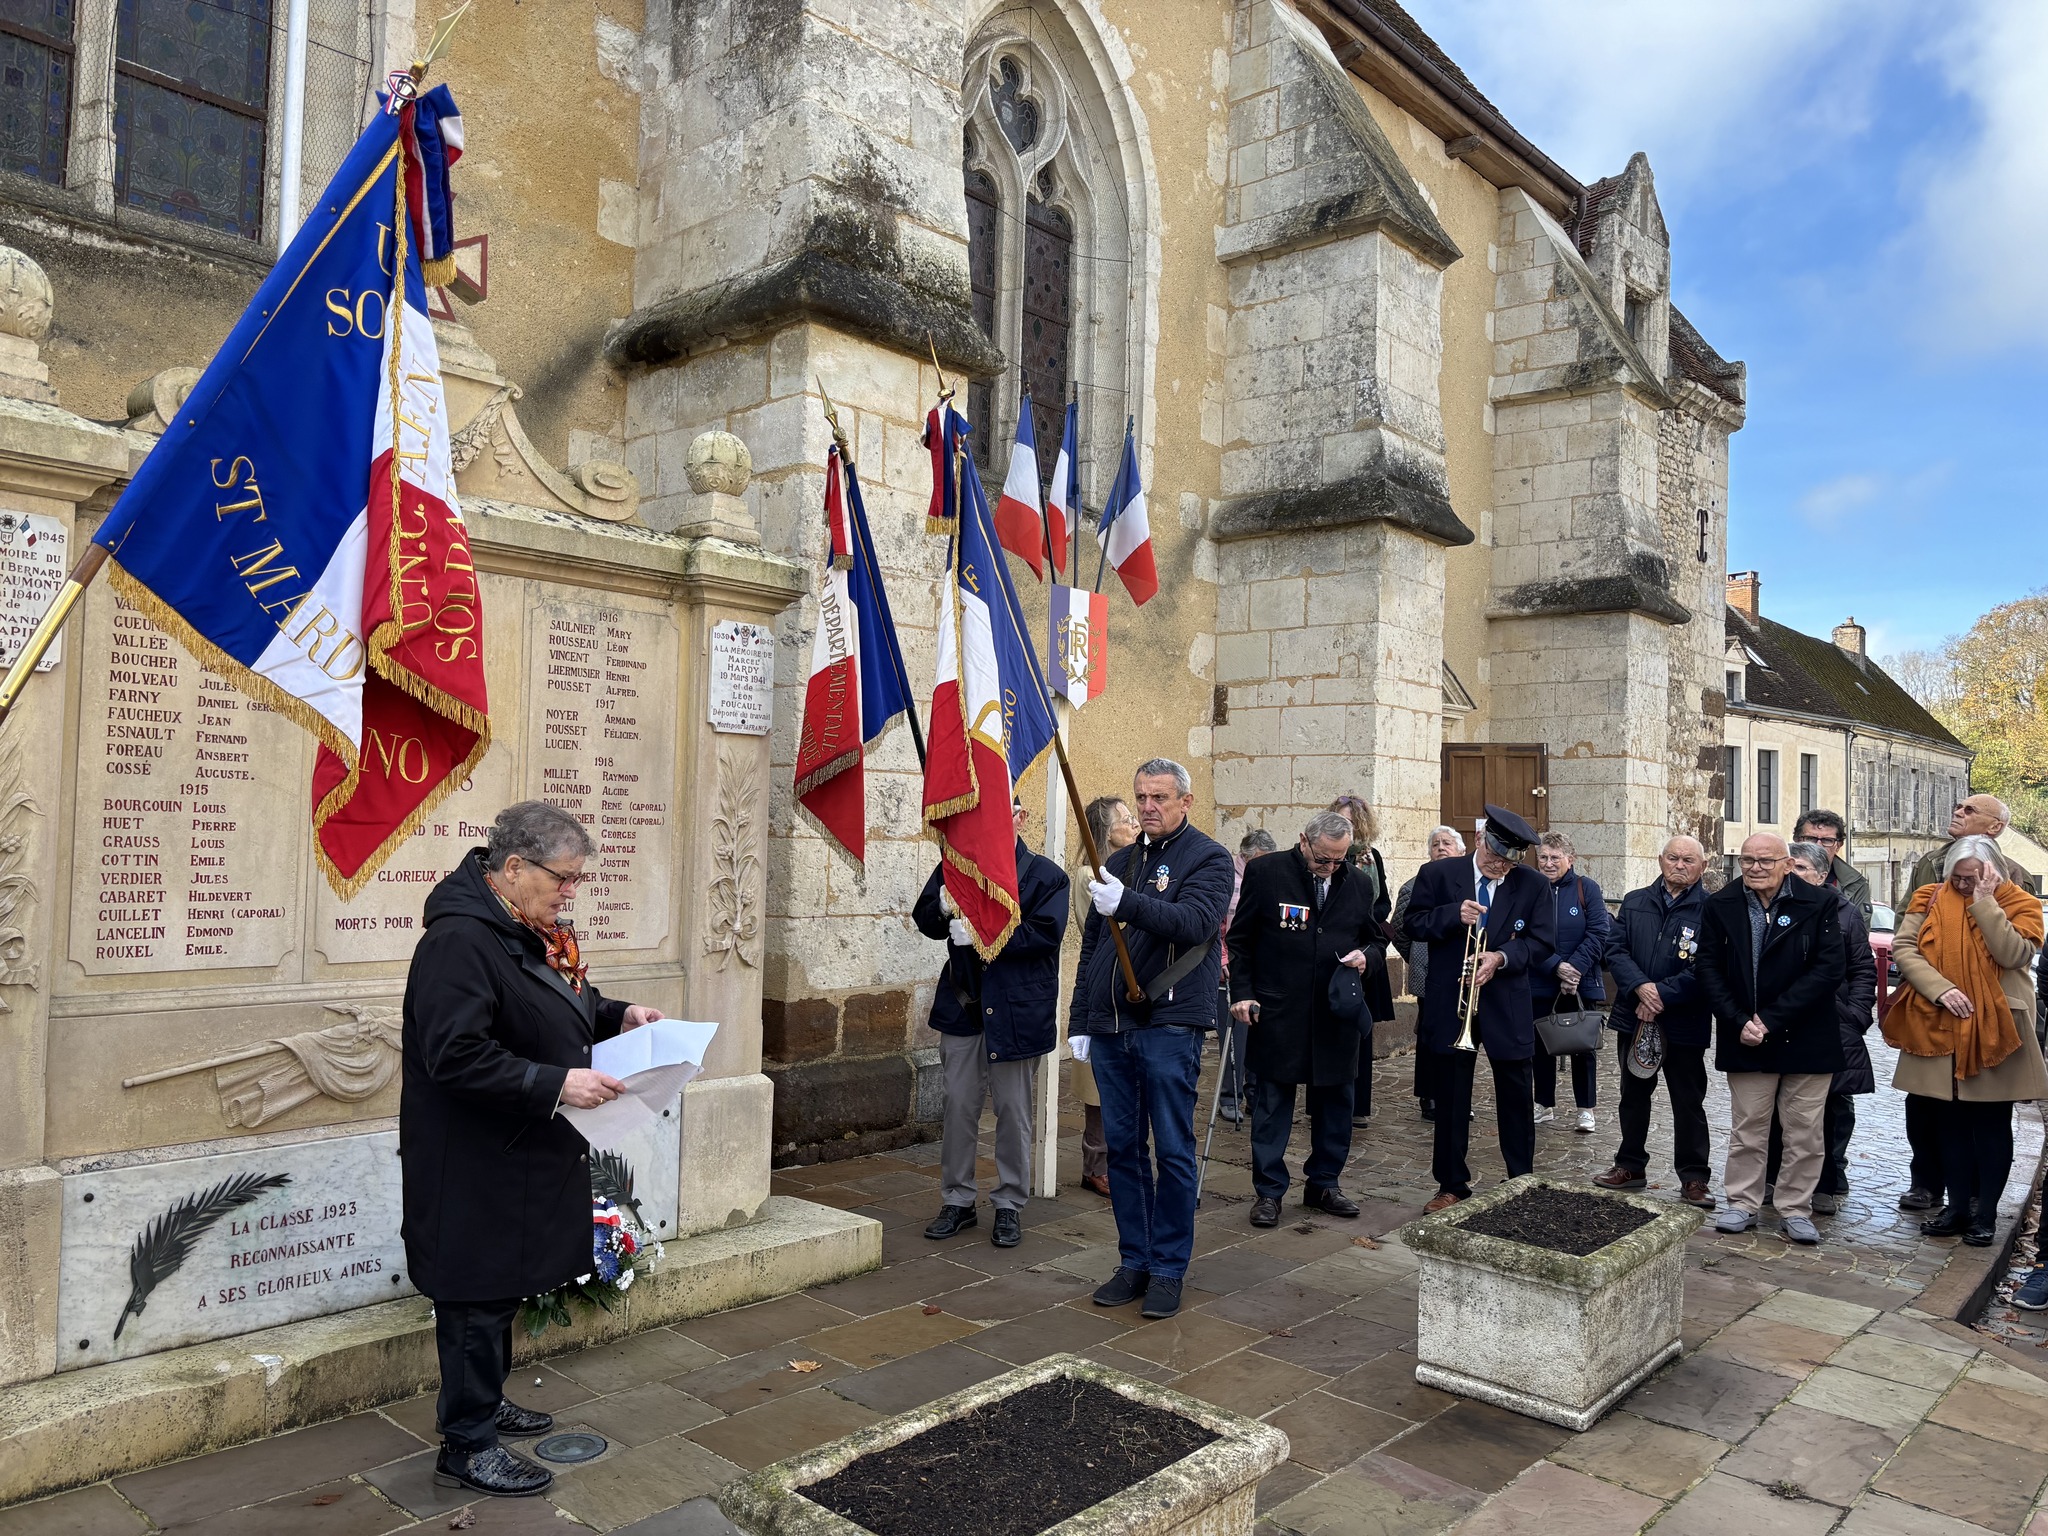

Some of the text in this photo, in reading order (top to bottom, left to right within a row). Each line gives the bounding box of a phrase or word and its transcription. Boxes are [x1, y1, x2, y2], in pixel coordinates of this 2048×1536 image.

[39, 531, 65, 544] 1945
[46, 554, 61, 564] DU
[8, 562, 62, 580] BERNARD
[210, 455, 365, 681] ST MARD
[6, 599, 21, 609] de
[599, 612, 618, 623] 1916
[550, 620, 632, 640] SAULNIER MARY
[112, 632, 168, 650] VALLÉE
[549, 635, 599, 650] ROUSSEAU
[110, 652, 177, 670] BOUCHER
[549, 650, 647, 670] VINCENT FERDINAND
[728, 655, 760, 665] MARCEL
[548, 665, 630, 683] LHERMUSIER HENRI
[727, 663, 759, 675] HARDY
[109, 670, 239, 692] MOLVEAU JULES
[547, 680, 591, 693] POUSSET
[109, 688, 161, 704] FARNY
[197, 696, 239, 710] DANIEL
[595, 699, 615, 710] 1917
[721, 700, 762, 711] FOUCAULT
[107, 707, 231, 727] FAUCHEUX JEAN
[546, 709, 636, 726] NOYER ARMAND
[107, 725, 247, 745] ESNAULT FERNAND
[545, 724, 587, 737] POUSSET
[106, 743, 249, 763] FOREAU ANSBERT
[106, 760, 152, 775] COSSÉ
[594, 757, 614, 767] 1918
[543, 768, 639, 783] MILLET RAYMOND
[180, 783, 209, 796] 1915
[543, 783, 629, 797] LOIGNARD ALCIDE
[193, 802, 226, 814] LOUIS
[629, 801, 666, 812] (CAPORAL)
[103, 817, 236, 832] HUET PIERRE
[629, 816, 665, 826] (CAPORAL)
[434, 825, 449, 836] DE
[601, 829, 636, 839] GEORGES
[191, 837, 225, 849] LOUIS
[600, 843, 636, 853] ANATOLE
[101, 854, 225, 867] COTTIN EMILE
[600, 858, 630, 868] JUSTIN
[100, 872, 229, 885] VERDIER JULES
[378, 870, 437, 883] GLORIEUX
[188, 890, 252, 902] HILDEVERT
[590, 886, 610, 897] 1919
[98, 906, 286, 922] GUILLET HENRI (CAPORAL)
[335, 917, 377, 930] MORTS
[384, 917, 413, 929] POUR
[589, 916, 610, 926] 1920
[96, 925, 234, 941] LANCELIN EDMOND
[96, 945, 153, 959] ROUXEL
[231, 1201, 358, 1236] LA CLASSE 1923
[230, 1233, 356, 1269] RECONNAISSANTE
[197, 1295, 208, 1310] A
[219, 1286, 247, 1305] SES
[257, 1267, 332, 1297] GLORIEUX
